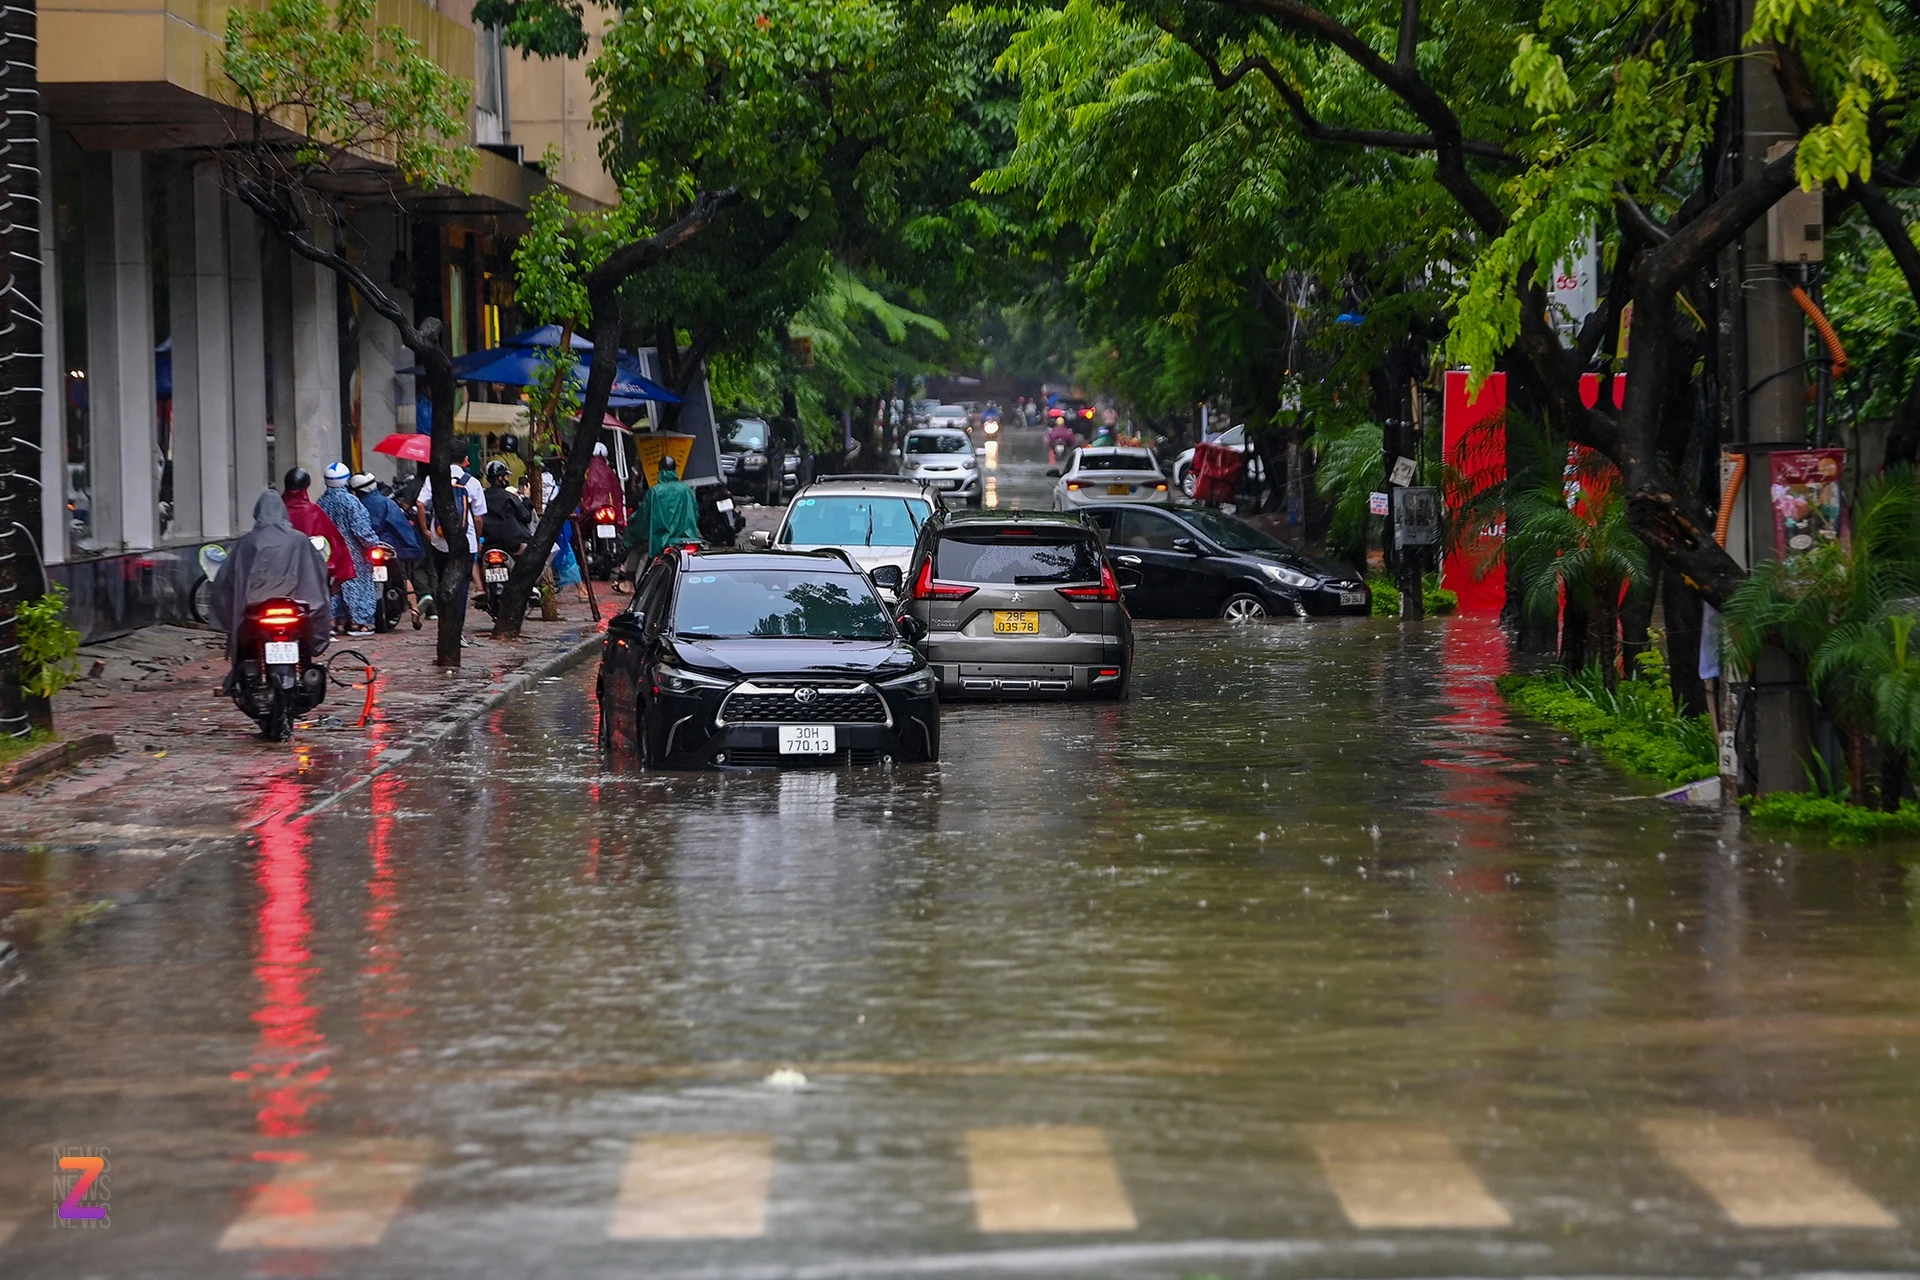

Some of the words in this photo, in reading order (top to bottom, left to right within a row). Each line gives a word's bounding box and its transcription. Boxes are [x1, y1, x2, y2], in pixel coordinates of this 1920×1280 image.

[1006, 611, 1026, 622] 29E
[796, 727, 819, 739] 30H
[786, 740, 829, 752] 770.13
